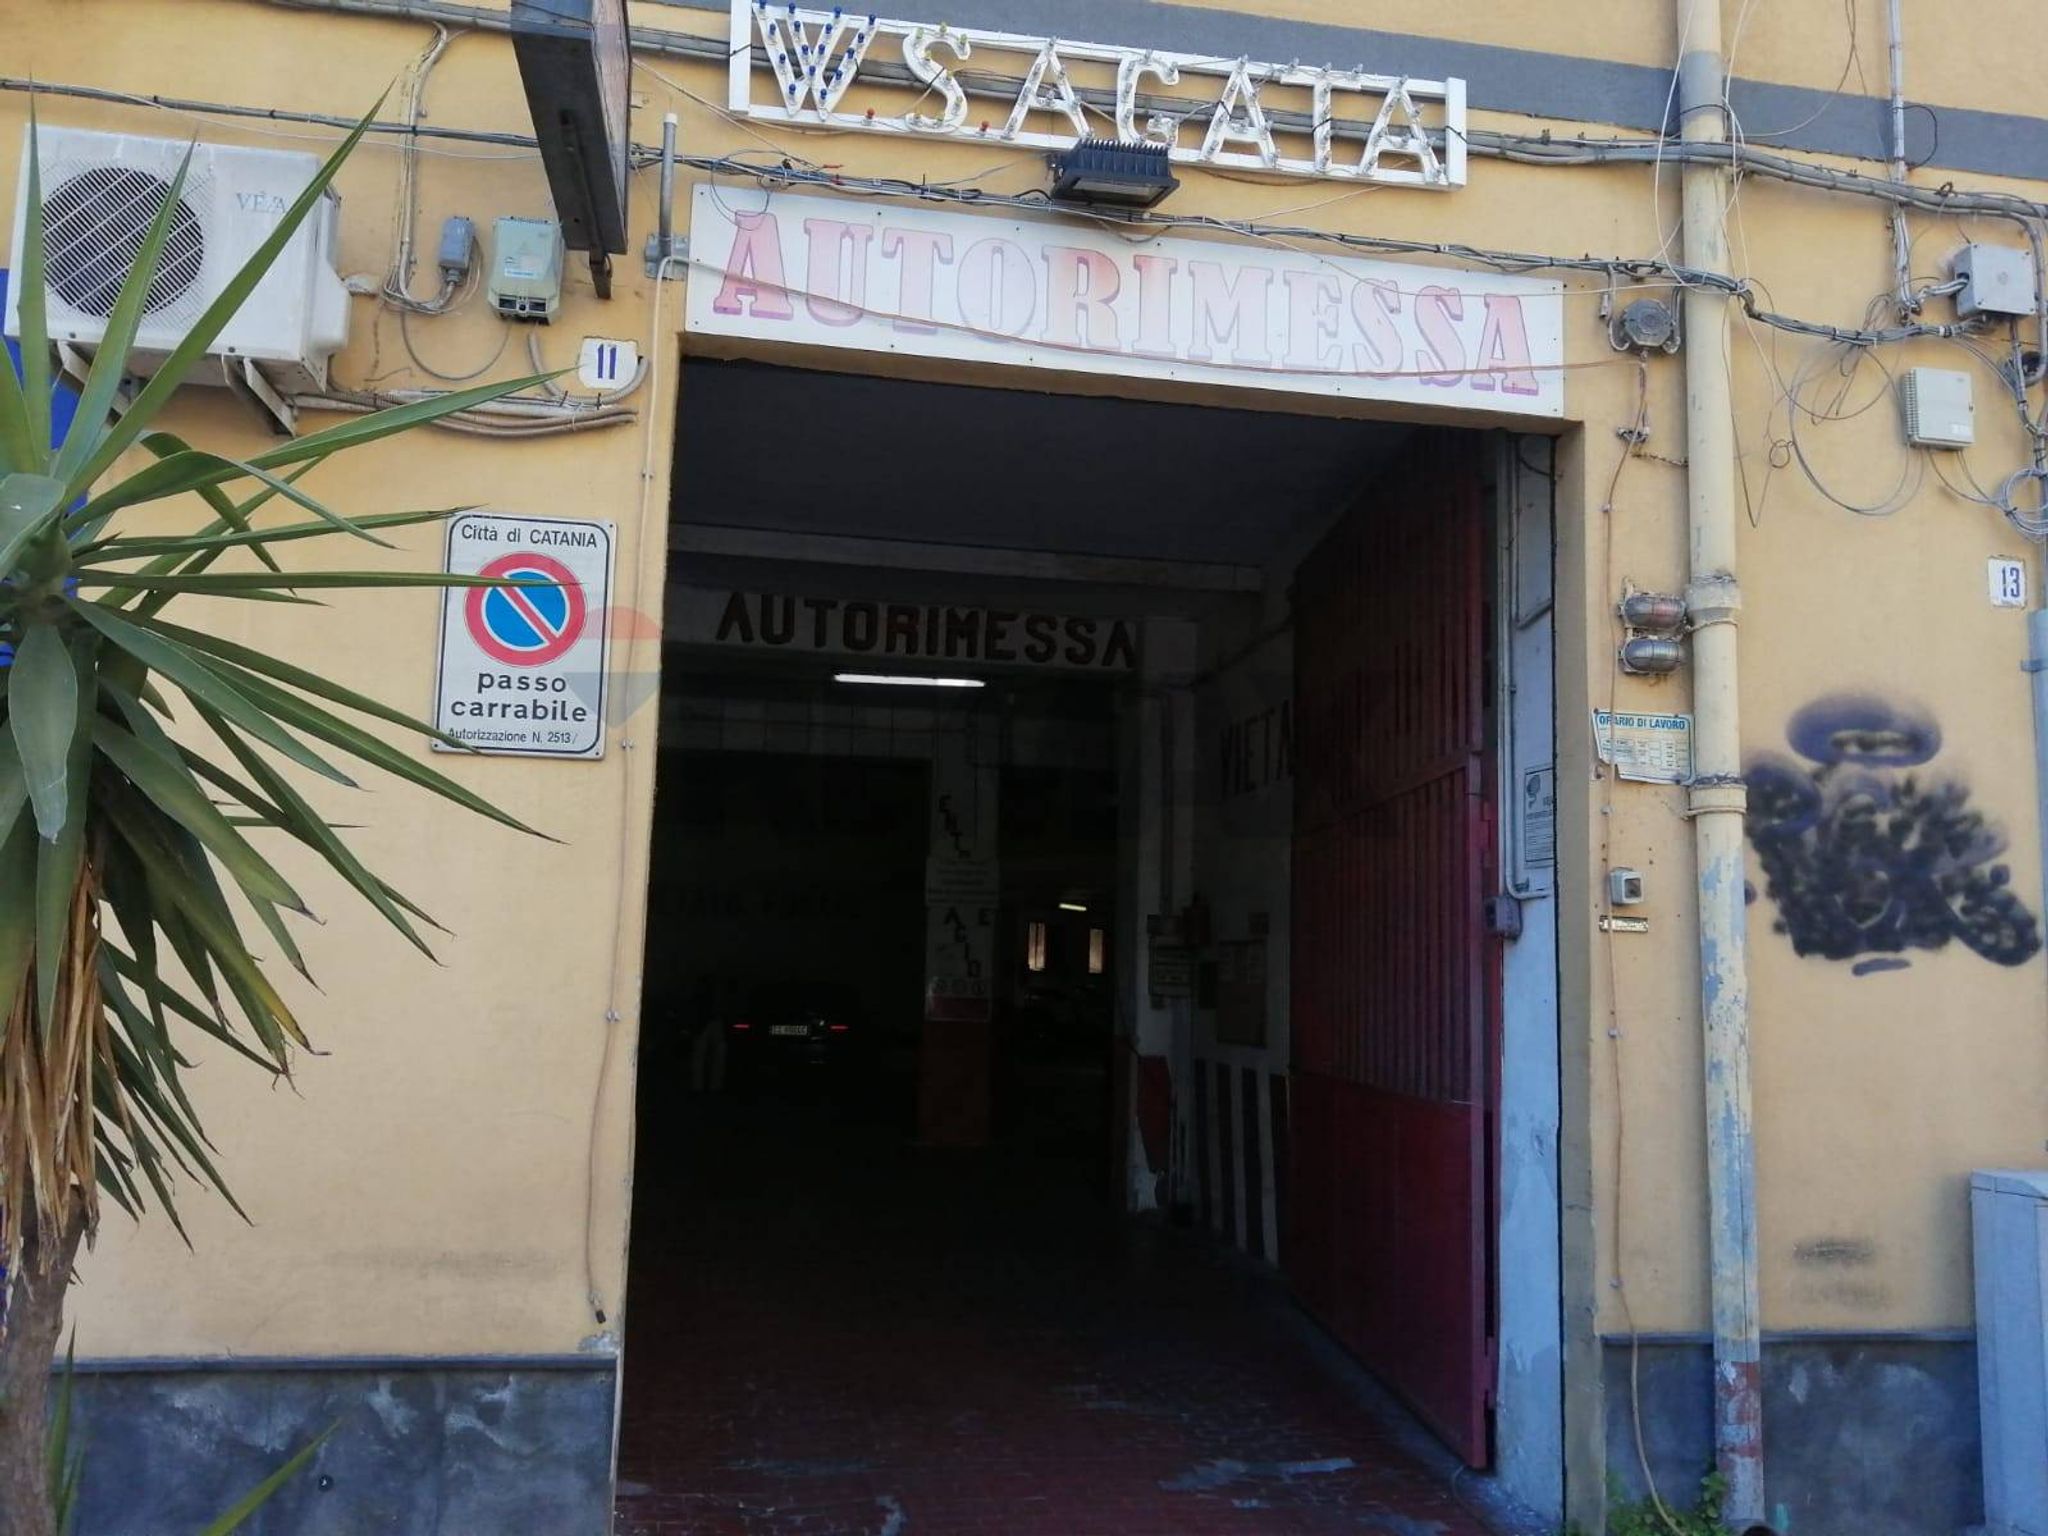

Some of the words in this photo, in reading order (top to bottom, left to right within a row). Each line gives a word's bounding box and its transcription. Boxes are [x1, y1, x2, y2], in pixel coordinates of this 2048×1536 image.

[1001, 38, 1447, 184] AGATA
[713, 210, 1540, 396] AUTORIMESSA
[597, 343, 617, 380] 11
[461, 523, 498, 542] Città
[506, 528, 521, 543] di
[529, 529, 598, 548] CATANIA
[2001, 566, 2020, 598] 13
[715, 589, 1138, 669] AUTORIMESSA
[477, 672, 567, 694] passo
[450, 698, 587, 722] carrabile
[449, 727, 527, 742] Autorizzazione
[1637, 718, 1647, 727] DI
[1649, 718, 1686, 731] LAVORO
